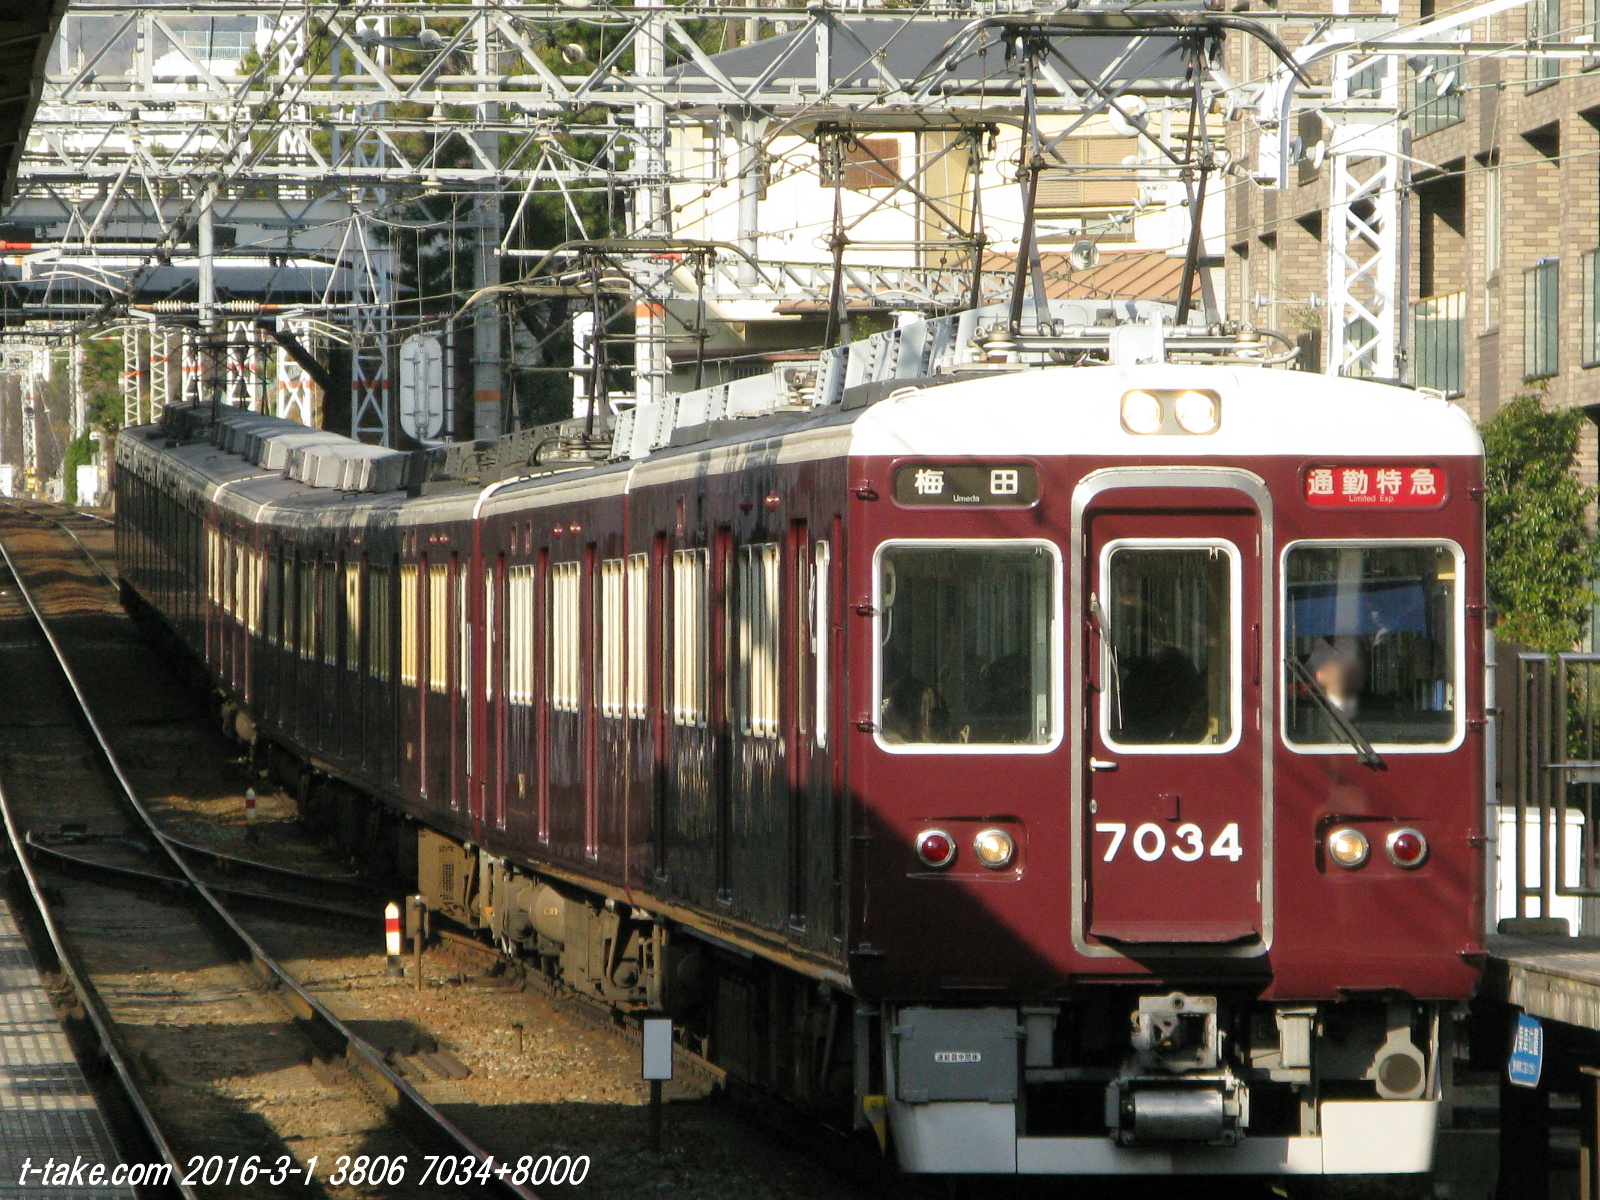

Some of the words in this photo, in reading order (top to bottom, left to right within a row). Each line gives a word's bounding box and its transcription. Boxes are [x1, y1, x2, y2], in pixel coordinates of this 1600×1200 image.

[914, 469, 1019, 495] 梅田
[1308, 469, 1437, 495] 通勤特急
[953, 494, 980, 503] Umeda
[1095, 822, 1243, 862] 7034
